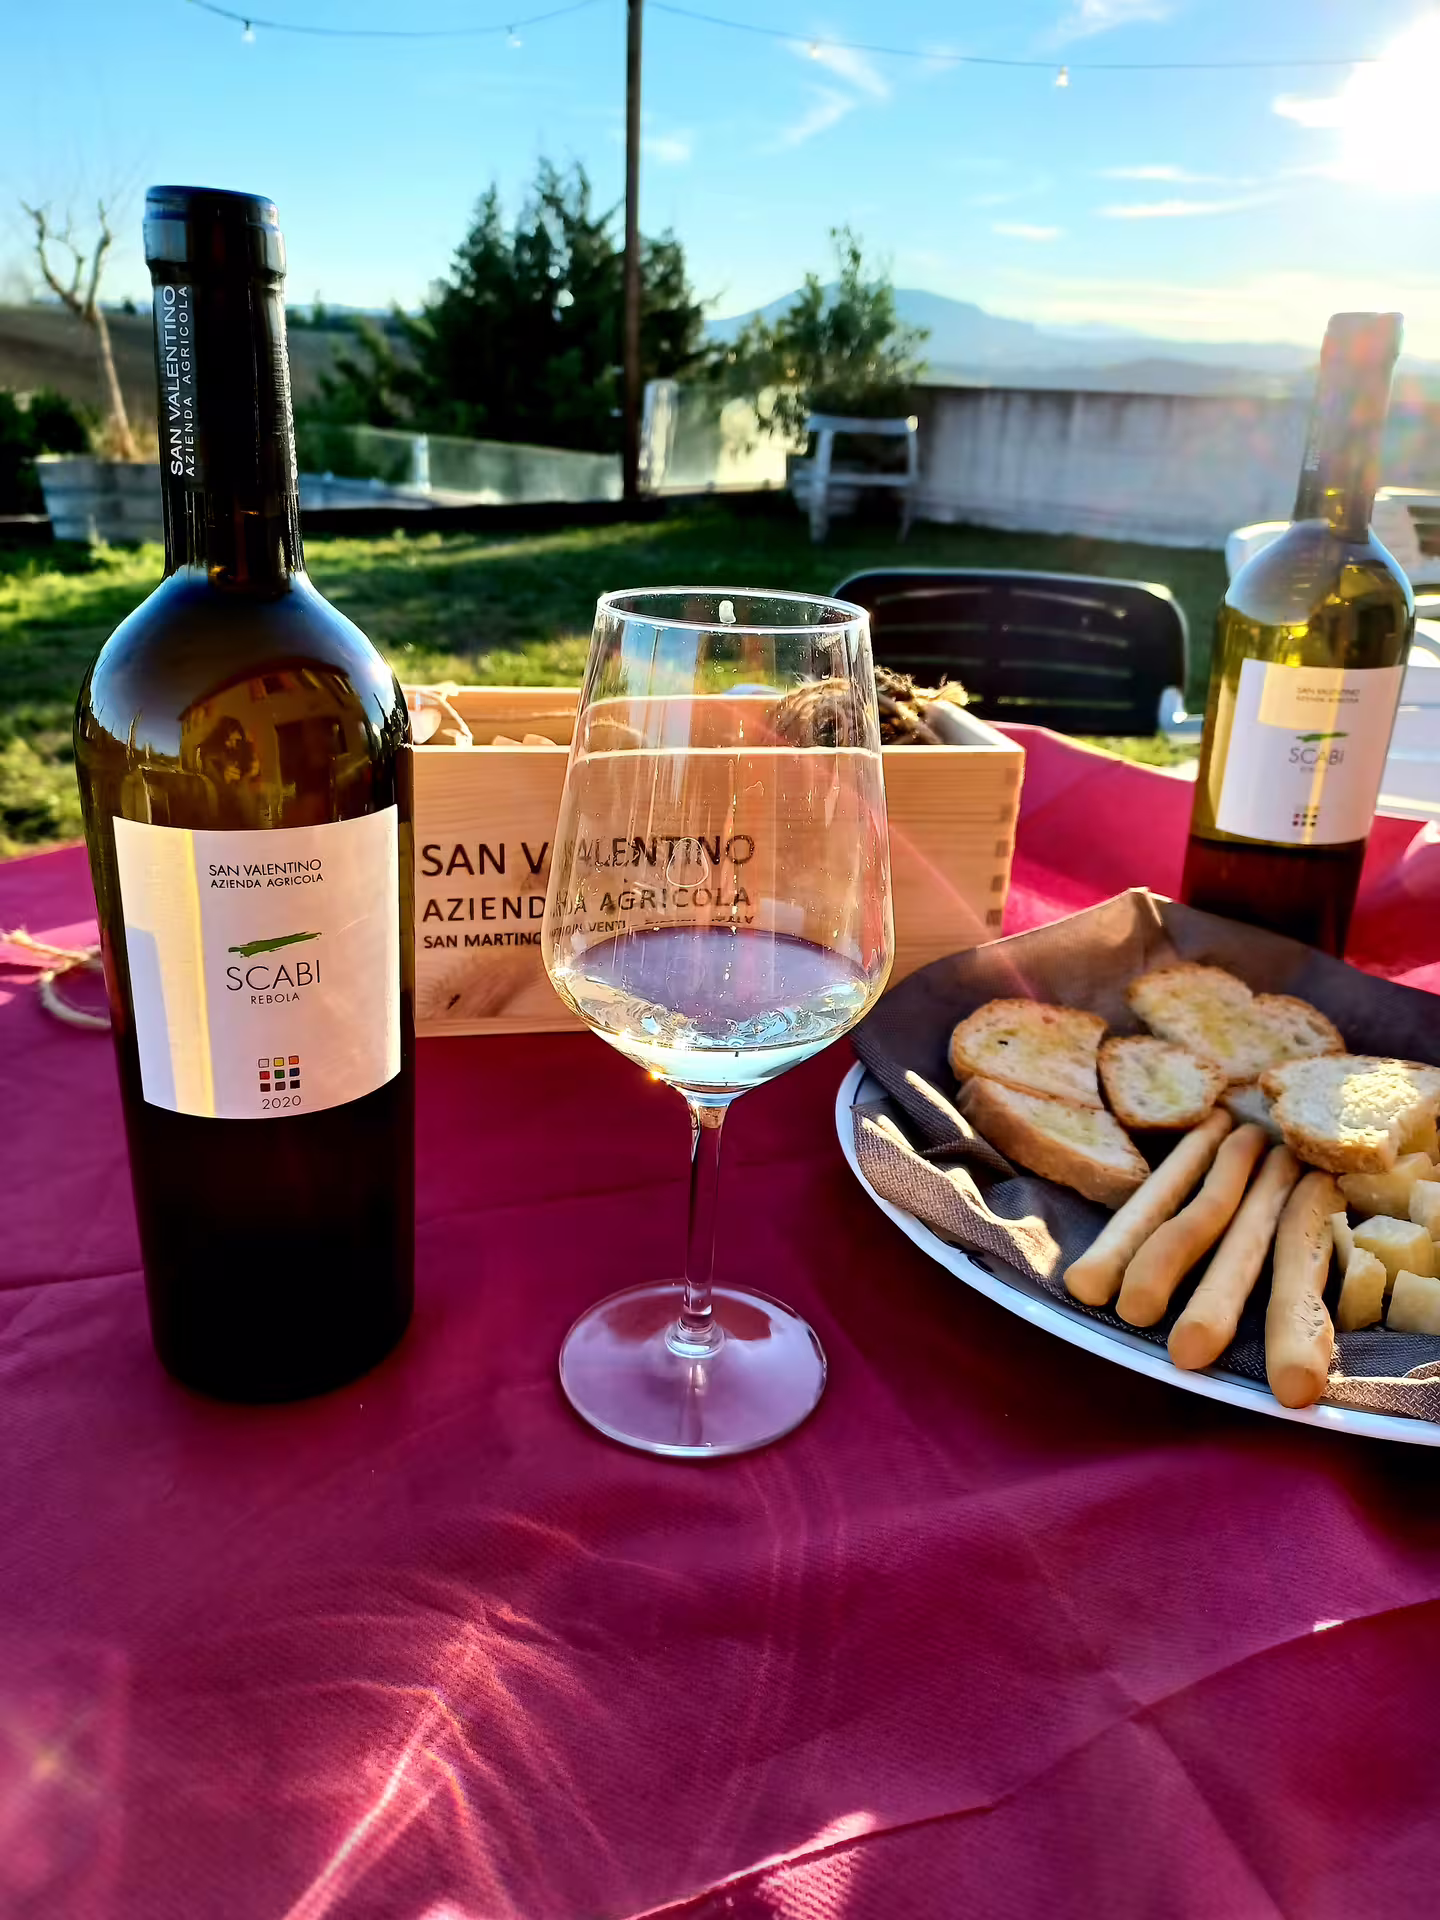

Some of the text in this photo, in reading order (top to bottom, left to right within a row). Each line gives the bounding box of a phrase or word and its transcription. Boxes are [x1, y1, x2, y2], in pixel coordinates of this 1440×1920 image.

[162, 285, 184, 476] SAN VALENTINO
[178, 285, 195, 477] AZIENDA AGRICOLA
[208, 858, 322, 877] SAN VALENTINO
[421, 843, 506, 877] SAN
[210, 873, 324, 889] AZIENDA AGRICOLA
[599, 886, 751, 913] AGRICOLA
[423, 935, 458, 949] SAN
[588, 920, 627, 933] VENTI
[225, 959, 322, 992] SCABI
[250, 991, 301, 1005] REBOLA
[261, 1095, 302, 1111] 2020
